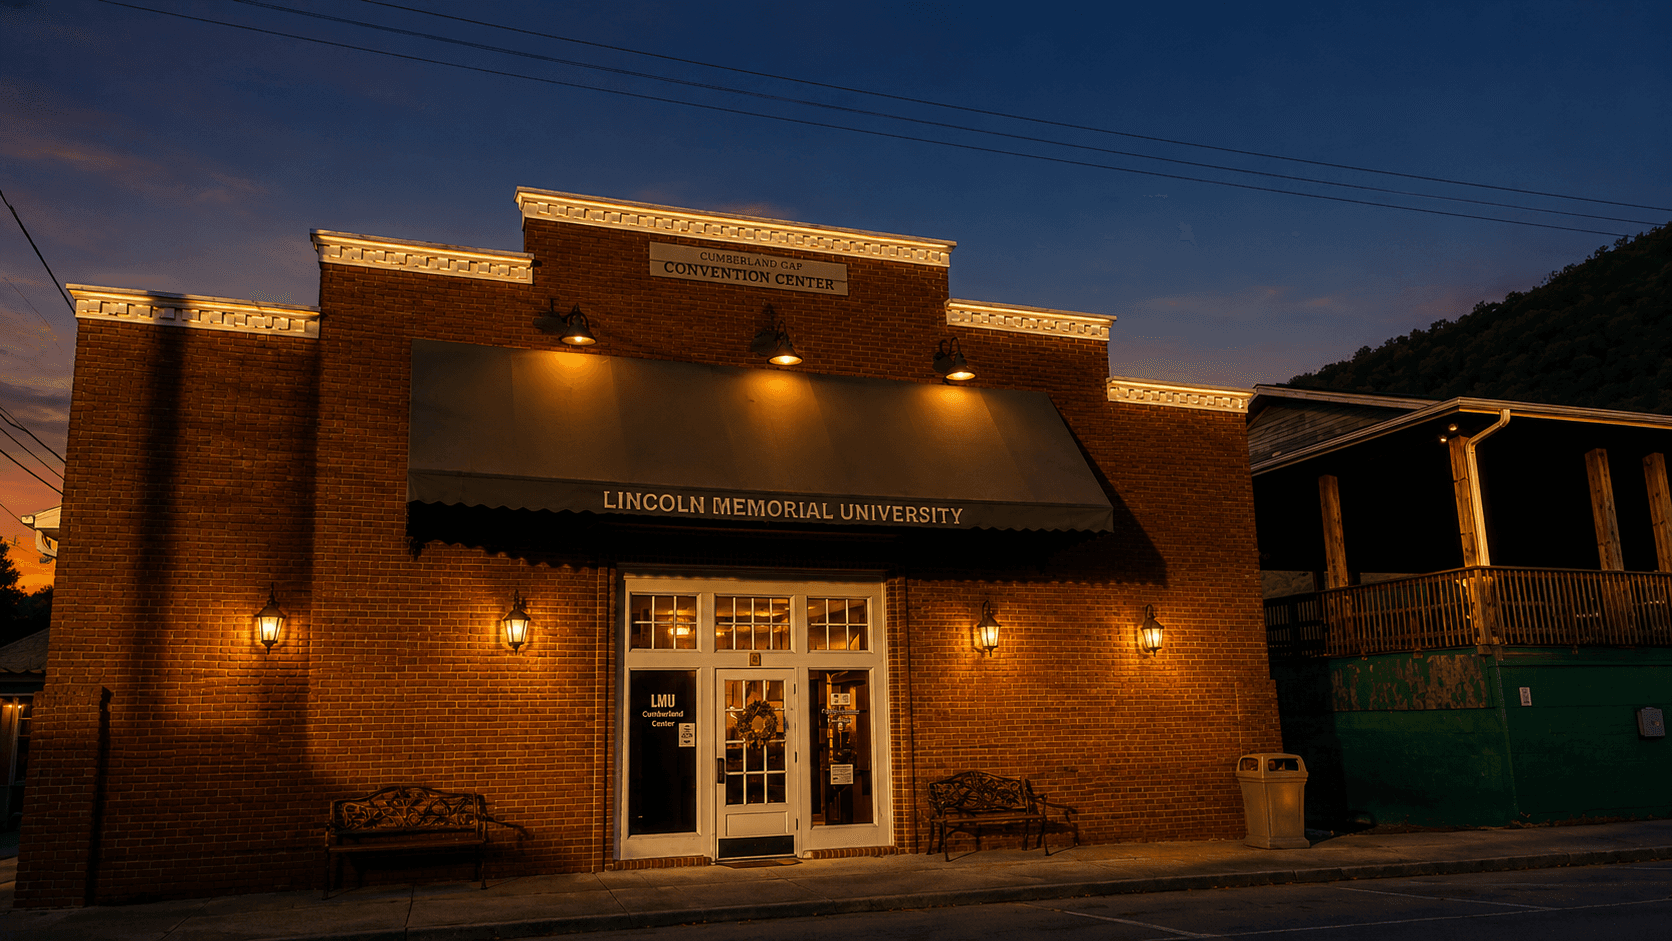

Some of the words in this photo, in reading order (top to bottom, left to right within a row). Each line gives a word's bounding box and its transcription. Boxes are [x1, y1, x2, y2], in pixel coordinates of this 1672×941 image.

[700, 251, 778, 268] CUMBERLAND
[781, 261, 803, 270] GAP
[664, 261, 770, 283] CONVENTION
[775, 273, 835, 290] CENTER
[603, 490, 705, 514] LINCOLN
[712, 496, 834, 520] MEMORIAL
[840, 503, 964, 525] UNIVERSITY
[650, 693, 676, 708] LMU
[642, 710, 684, 718] Cumberland
